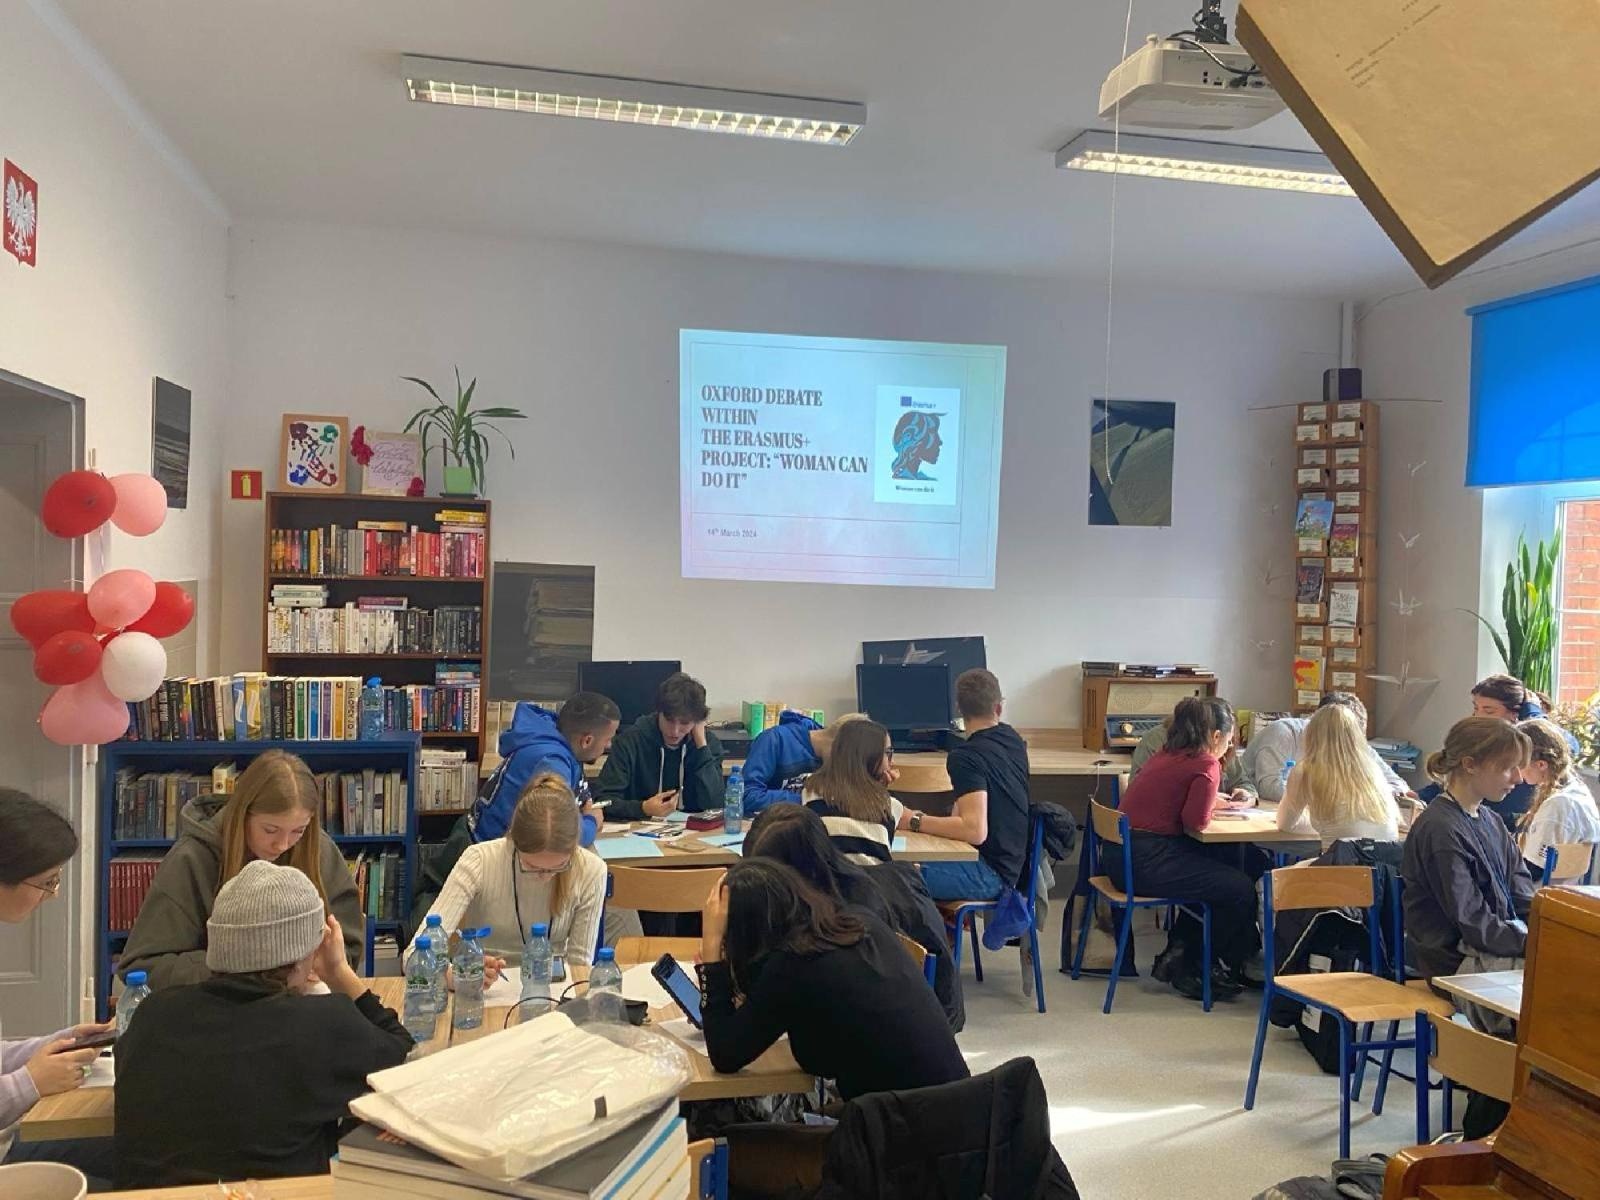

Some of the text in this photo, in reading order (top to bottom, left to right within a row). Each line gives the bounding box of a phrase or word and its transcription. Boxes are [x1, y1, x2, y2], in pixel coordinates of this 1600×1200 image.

[701, 384, 822, 406] OXFORD DEBATE
[701, 407, 758, 425] WITHIN
[701, 429, 811, 449] THE ERASMUS+
[701, 450, 771, 469] PROJECT:
[839, 456, 868, 473] CAN
[701, 472, 723, 487] DO
[720, 529, 740, 537] March
[742, 529, 757, 538] 2024
